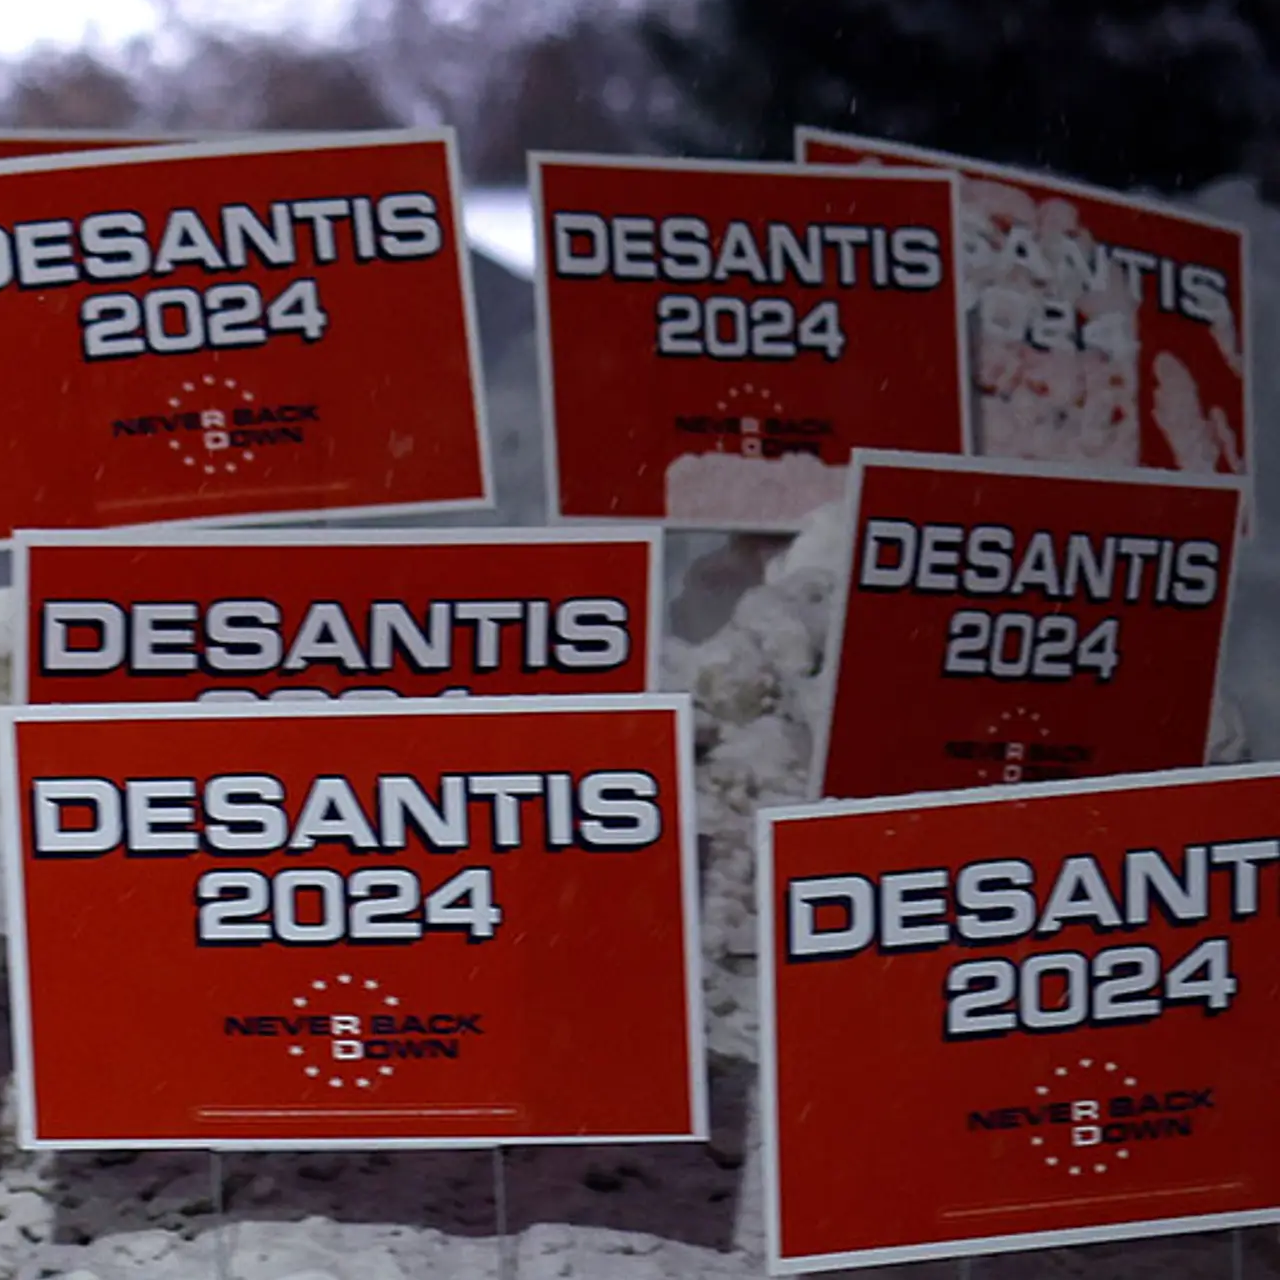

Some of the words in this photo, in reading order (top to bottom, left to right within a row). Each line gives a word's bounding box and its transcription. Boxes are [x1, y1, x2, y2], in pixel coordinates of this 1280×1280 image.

[553, 212, 942, 288] DESANTIS
[81, 279, 327, 357] 2024
[657, 294, 846, 358] 2024
[233, 404, 319, 425] BACK
[859, 519, 1219, 604] DESANTIS
[43, 598, 628, 671] DESANTIS
[944, 610, 1119, 680] 2024
[33, 771, 660, 853] DESANTIS
[197, 868, 502, 942] 2024
[789, 839, 1280, 956] DESANT
[947, 938, 1237, 1035] 2024
[371, 1014, 484, 1035] BACK
[1108, 1088, 1215, 1117] BACK
